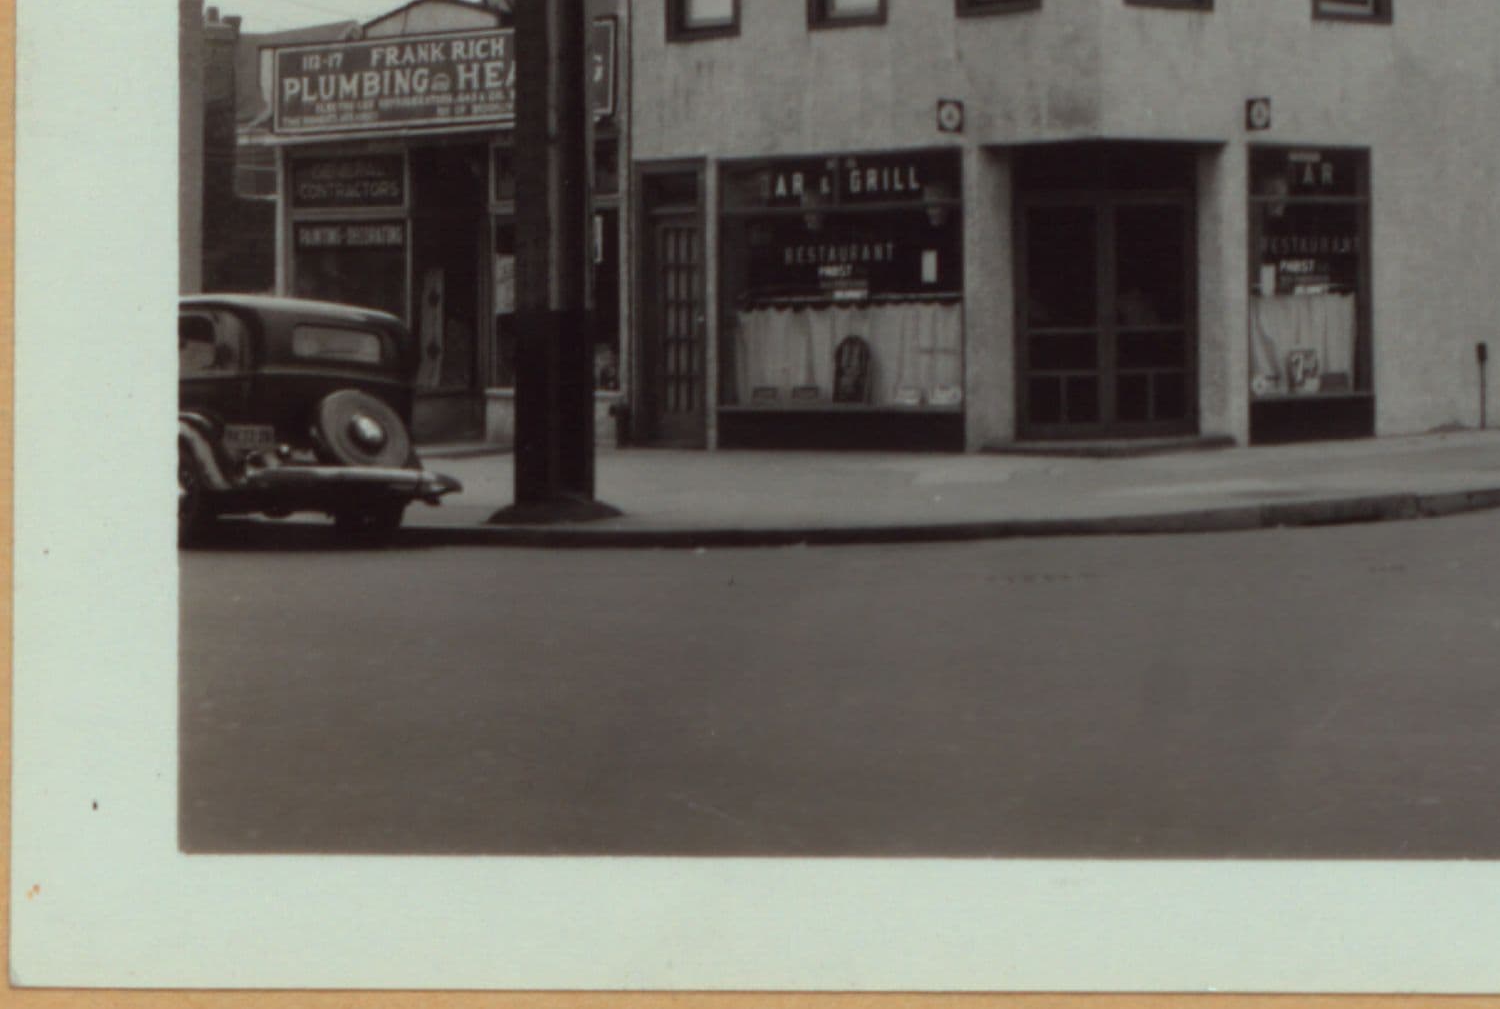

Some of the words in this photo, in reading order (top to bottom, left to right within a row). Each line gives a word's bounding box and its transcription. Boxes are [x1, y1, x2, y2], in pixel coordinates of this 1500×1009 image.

[370, 42, 445, 68] FRANK
[448, 37, 505, 61] RICH
[283, 68, 429, 103] PLUMBING
[849, 165, 921, 194] GRILL
[784, 242, 895, 266] RESTAURANT
